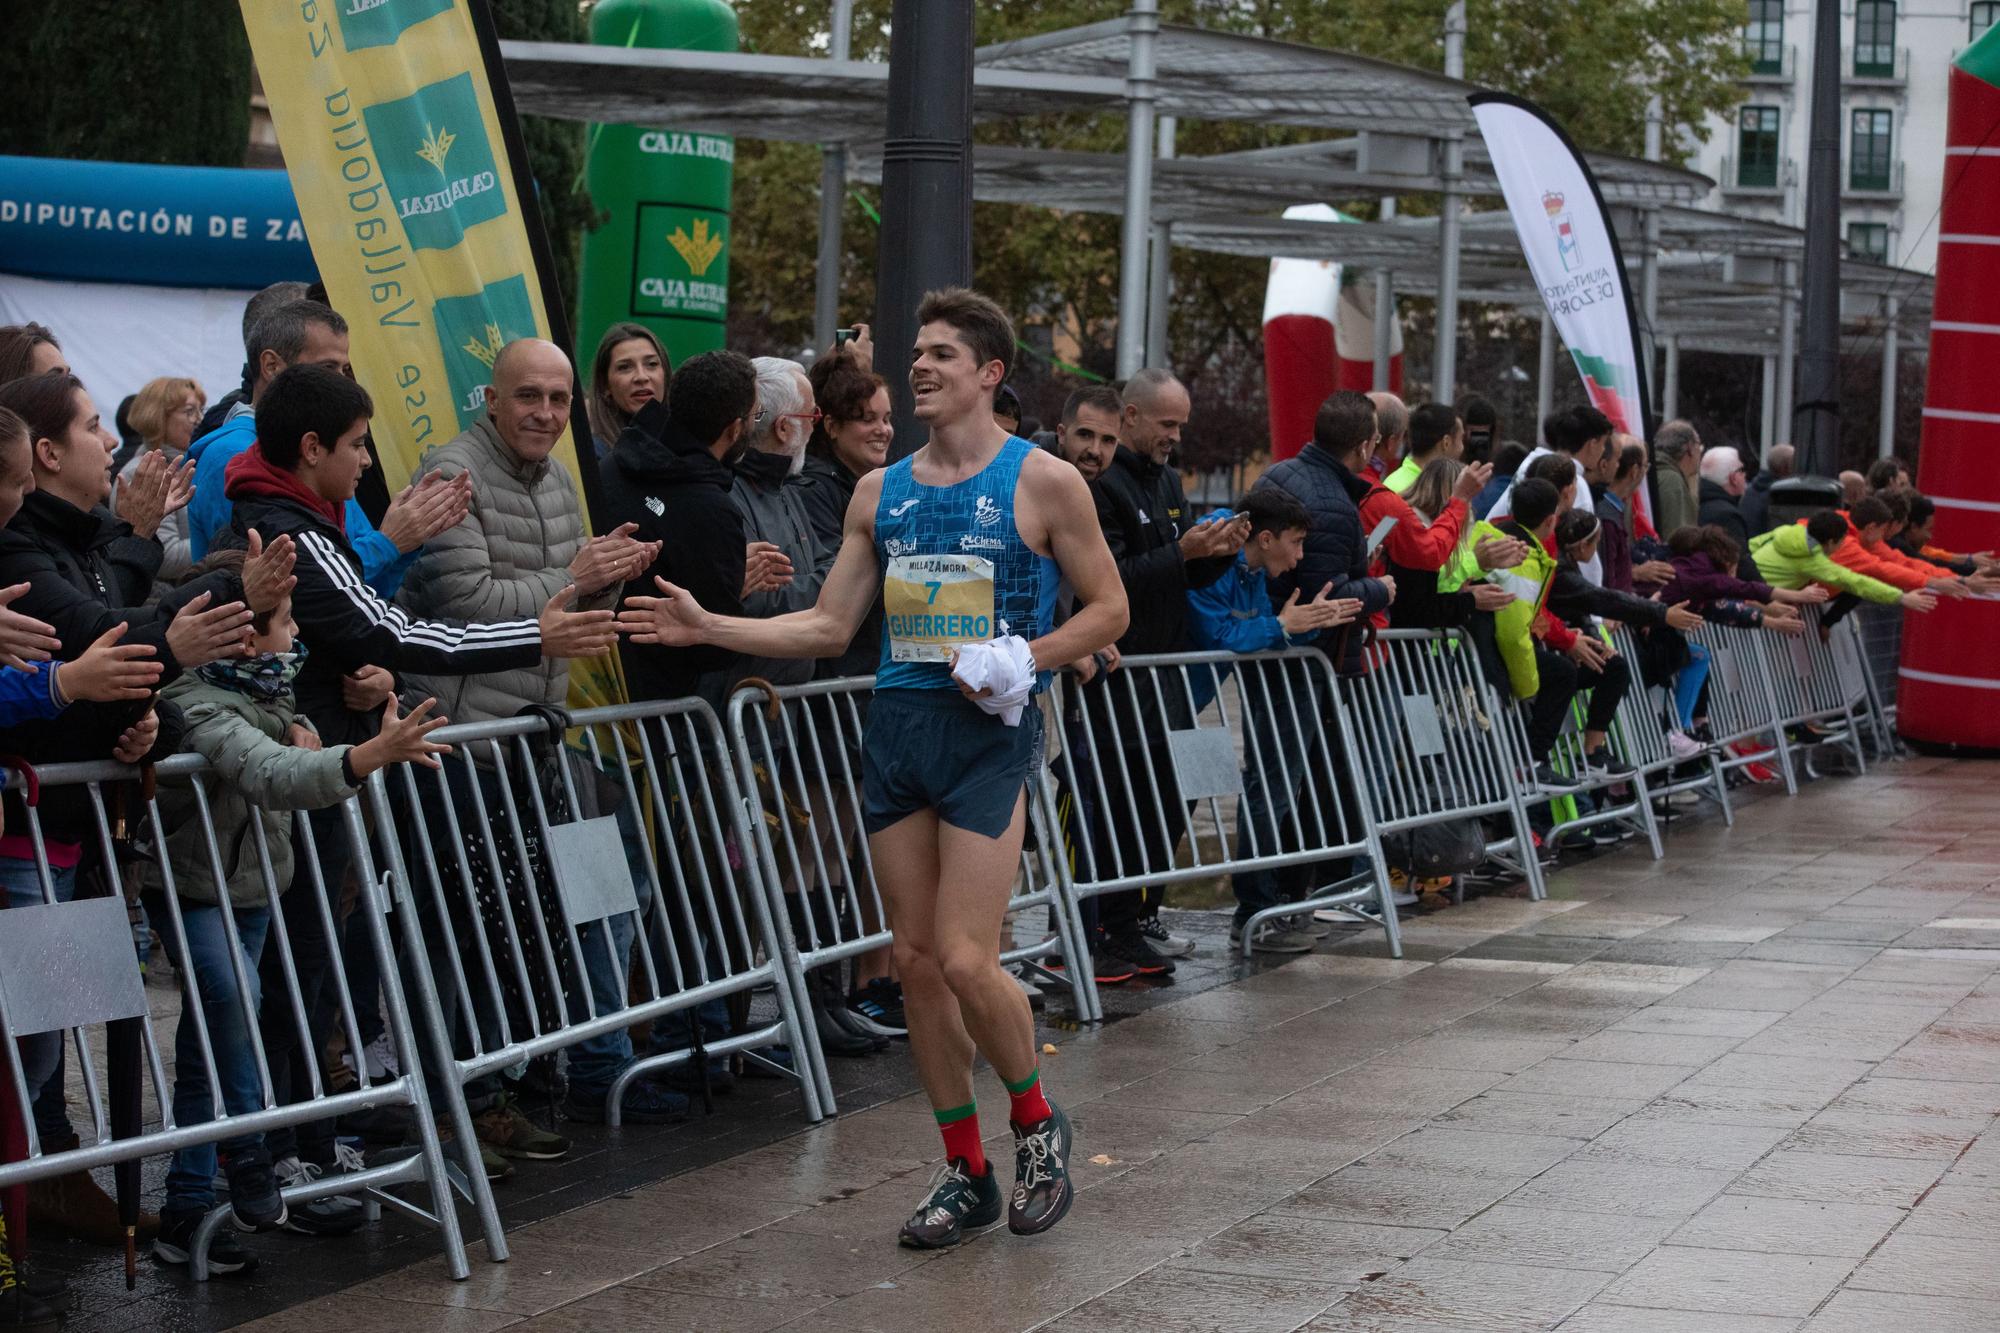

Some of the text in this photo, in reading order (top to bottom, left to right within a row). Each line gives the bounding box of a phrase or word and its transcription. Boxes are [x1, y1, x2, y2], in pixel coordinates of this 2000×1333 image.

[639, 132, 694, 157] CAJA
[1, 201, 192, 236] DIPUTACIÓN
[209, 216, 248, 239] DE
[640, 278, 690, 299] CAJA
[924, 581, 943, 605] 7
[889, 613, 990, 638] GUERRERO
